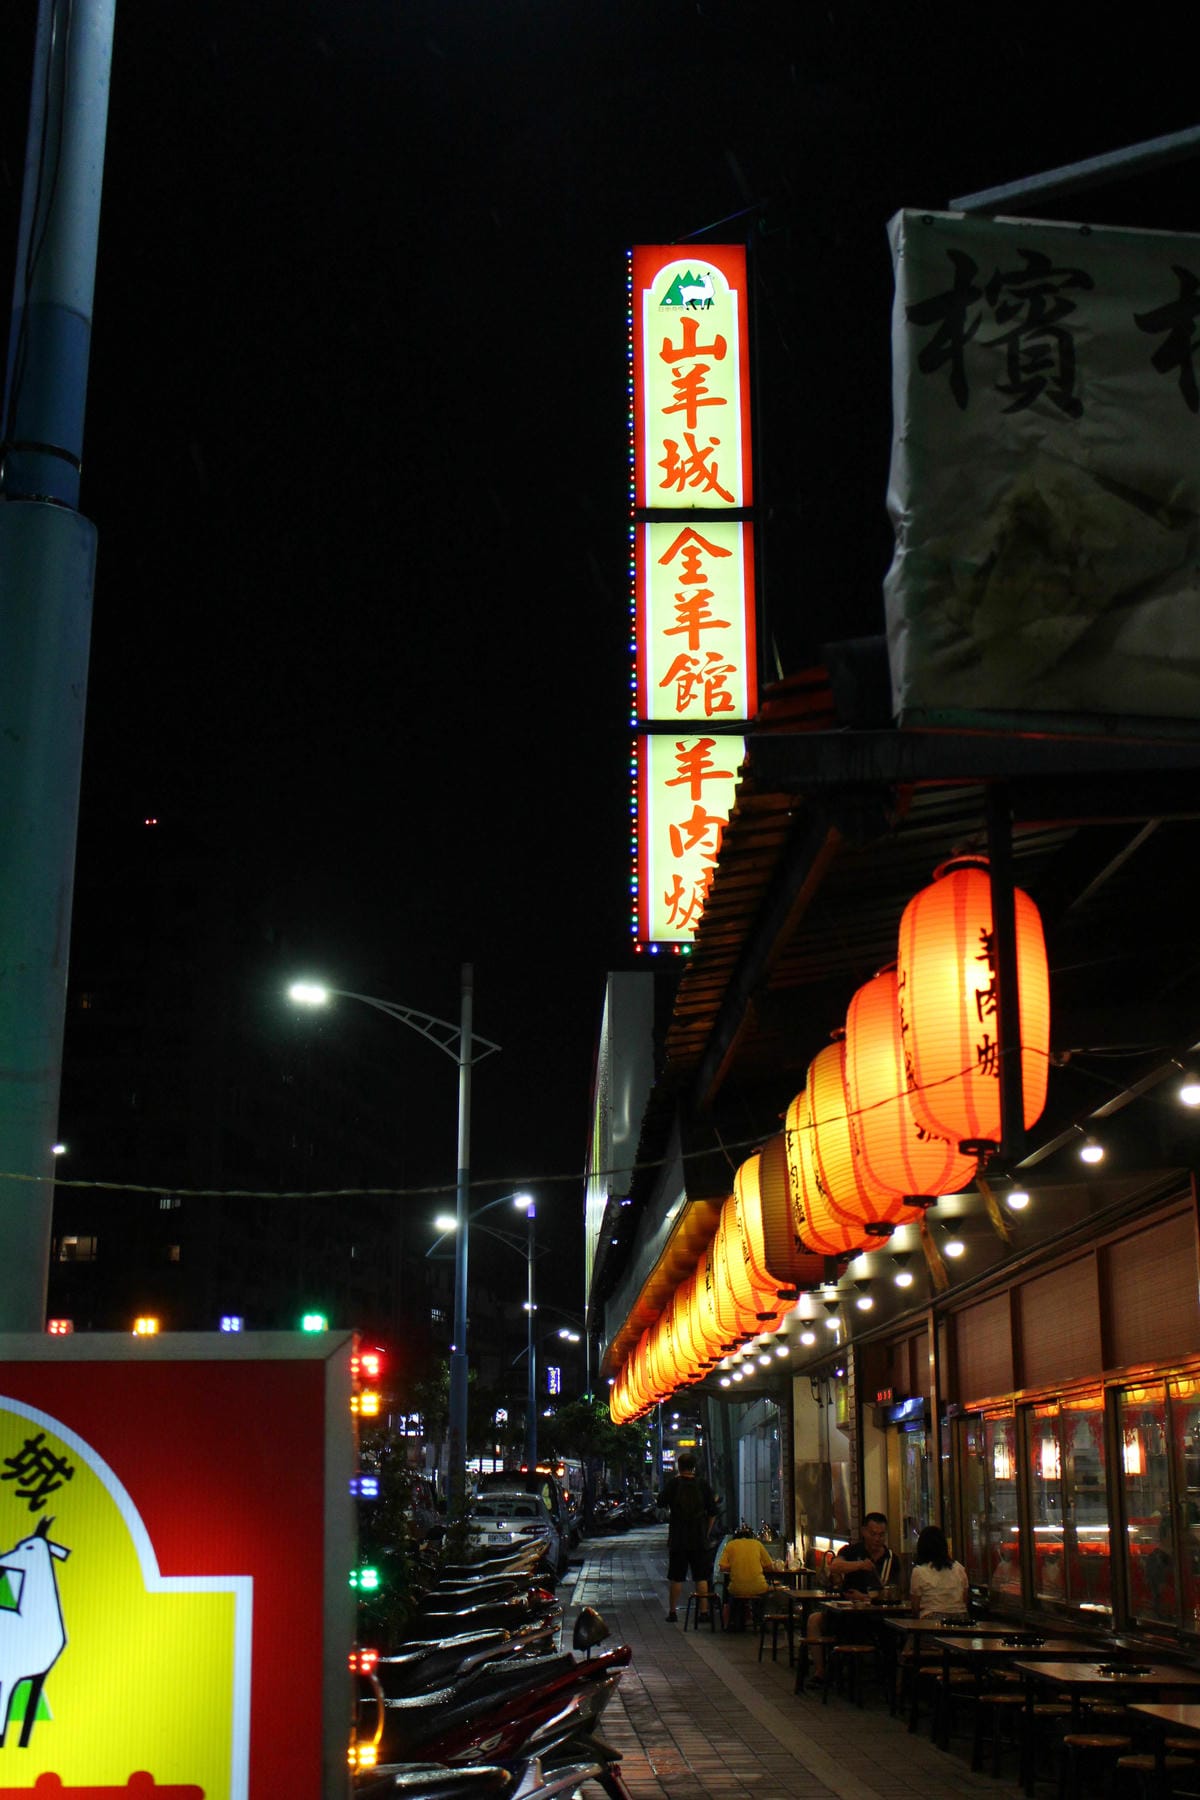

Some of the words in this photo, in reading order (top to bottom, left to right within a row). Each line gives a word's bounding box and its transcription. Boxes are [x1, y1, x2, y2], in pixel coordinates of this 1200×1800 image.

[658, 316, 735, 503] 山羊城
[658, 526, 736, 717] 全羊館
[1, 1432, 74, 1511] 城
